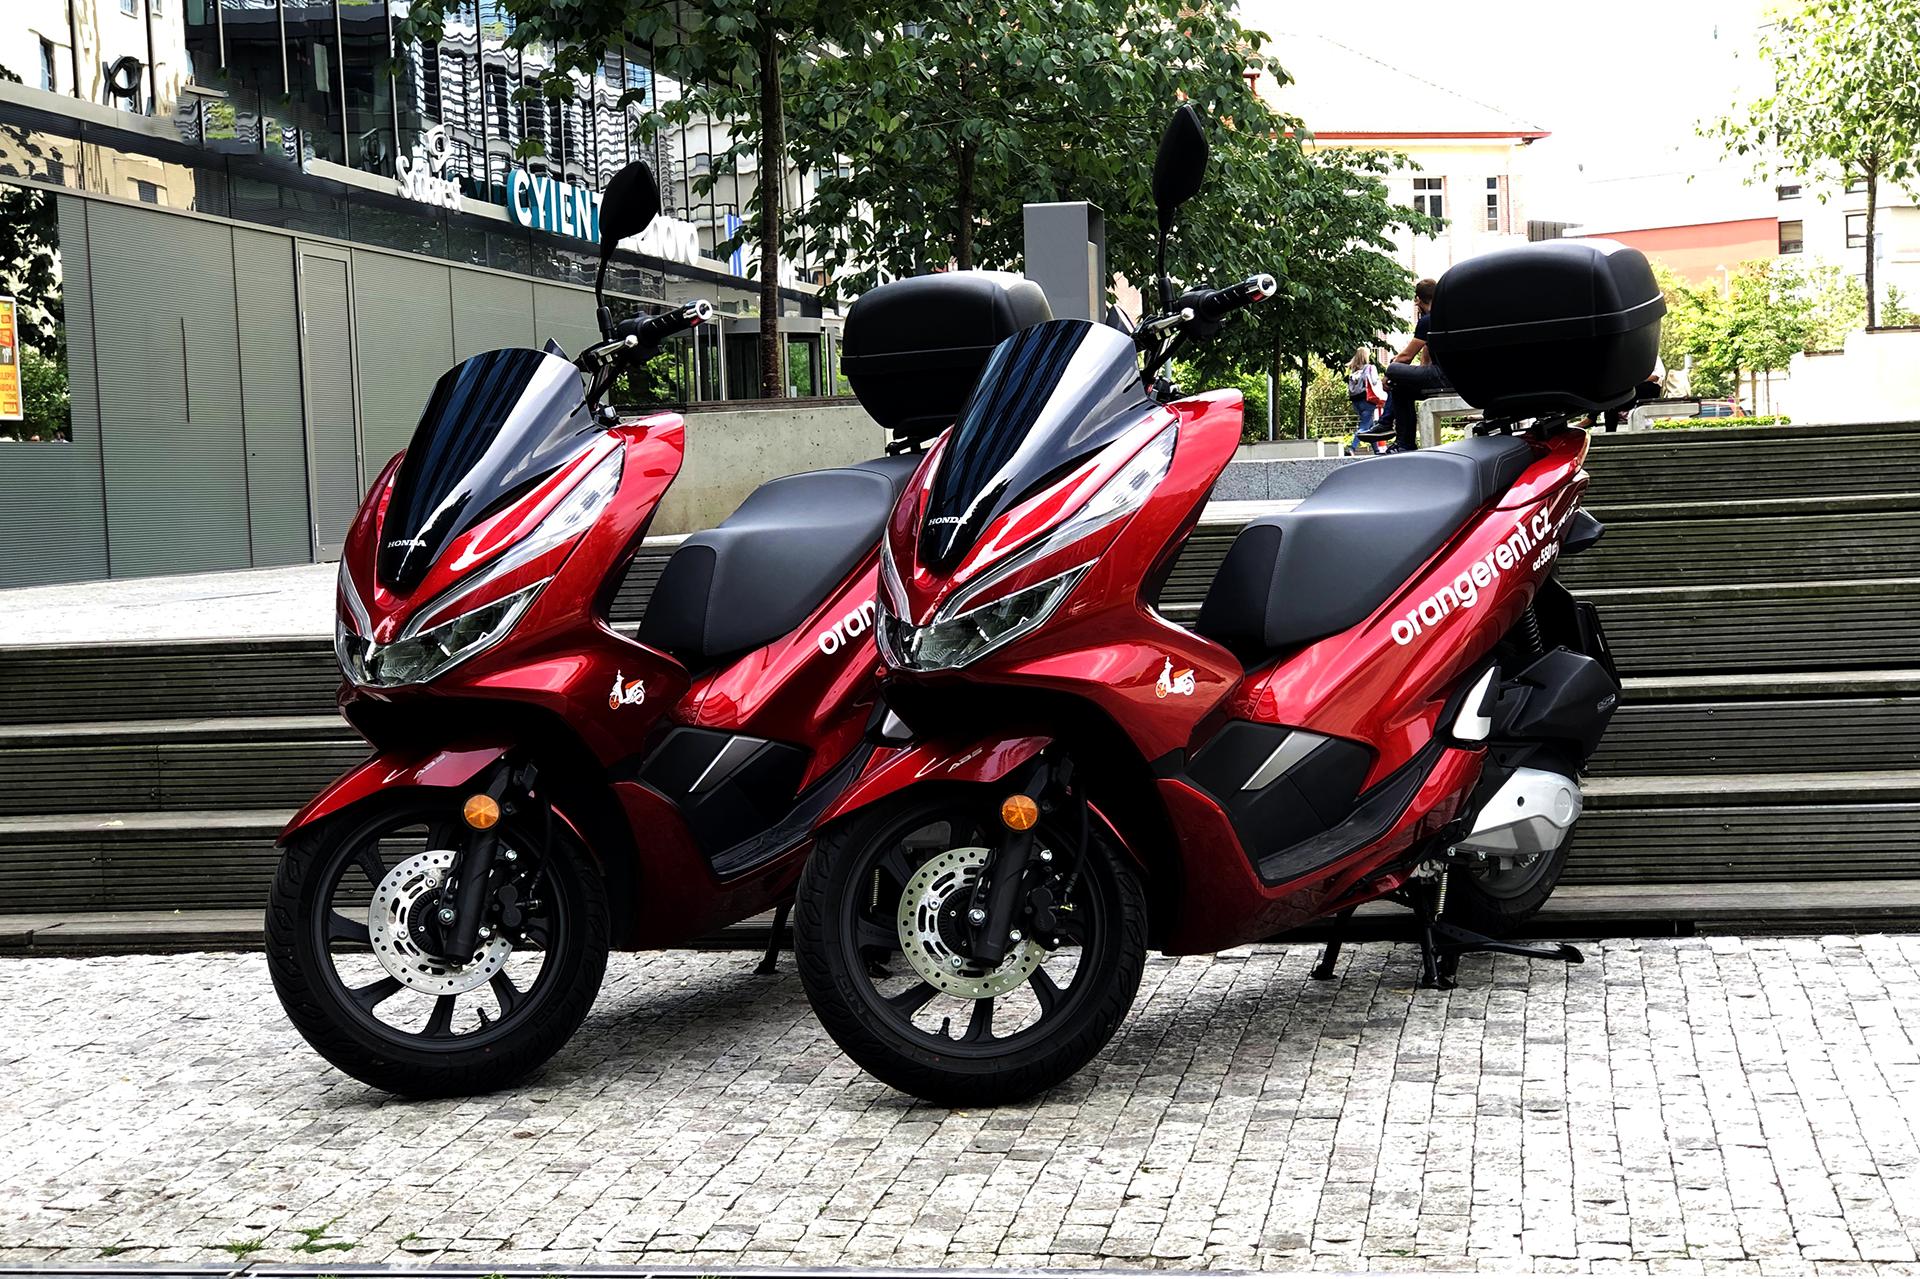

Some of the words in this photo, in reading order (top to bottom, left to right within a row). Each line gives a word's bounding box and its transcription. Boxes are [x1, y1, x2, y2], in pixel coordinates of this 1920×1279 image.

[928, 516, 968, 526] HONDA
[1391, 506, 1552, 646] orangerent.cz
[818, 600, 876, 655] oran
